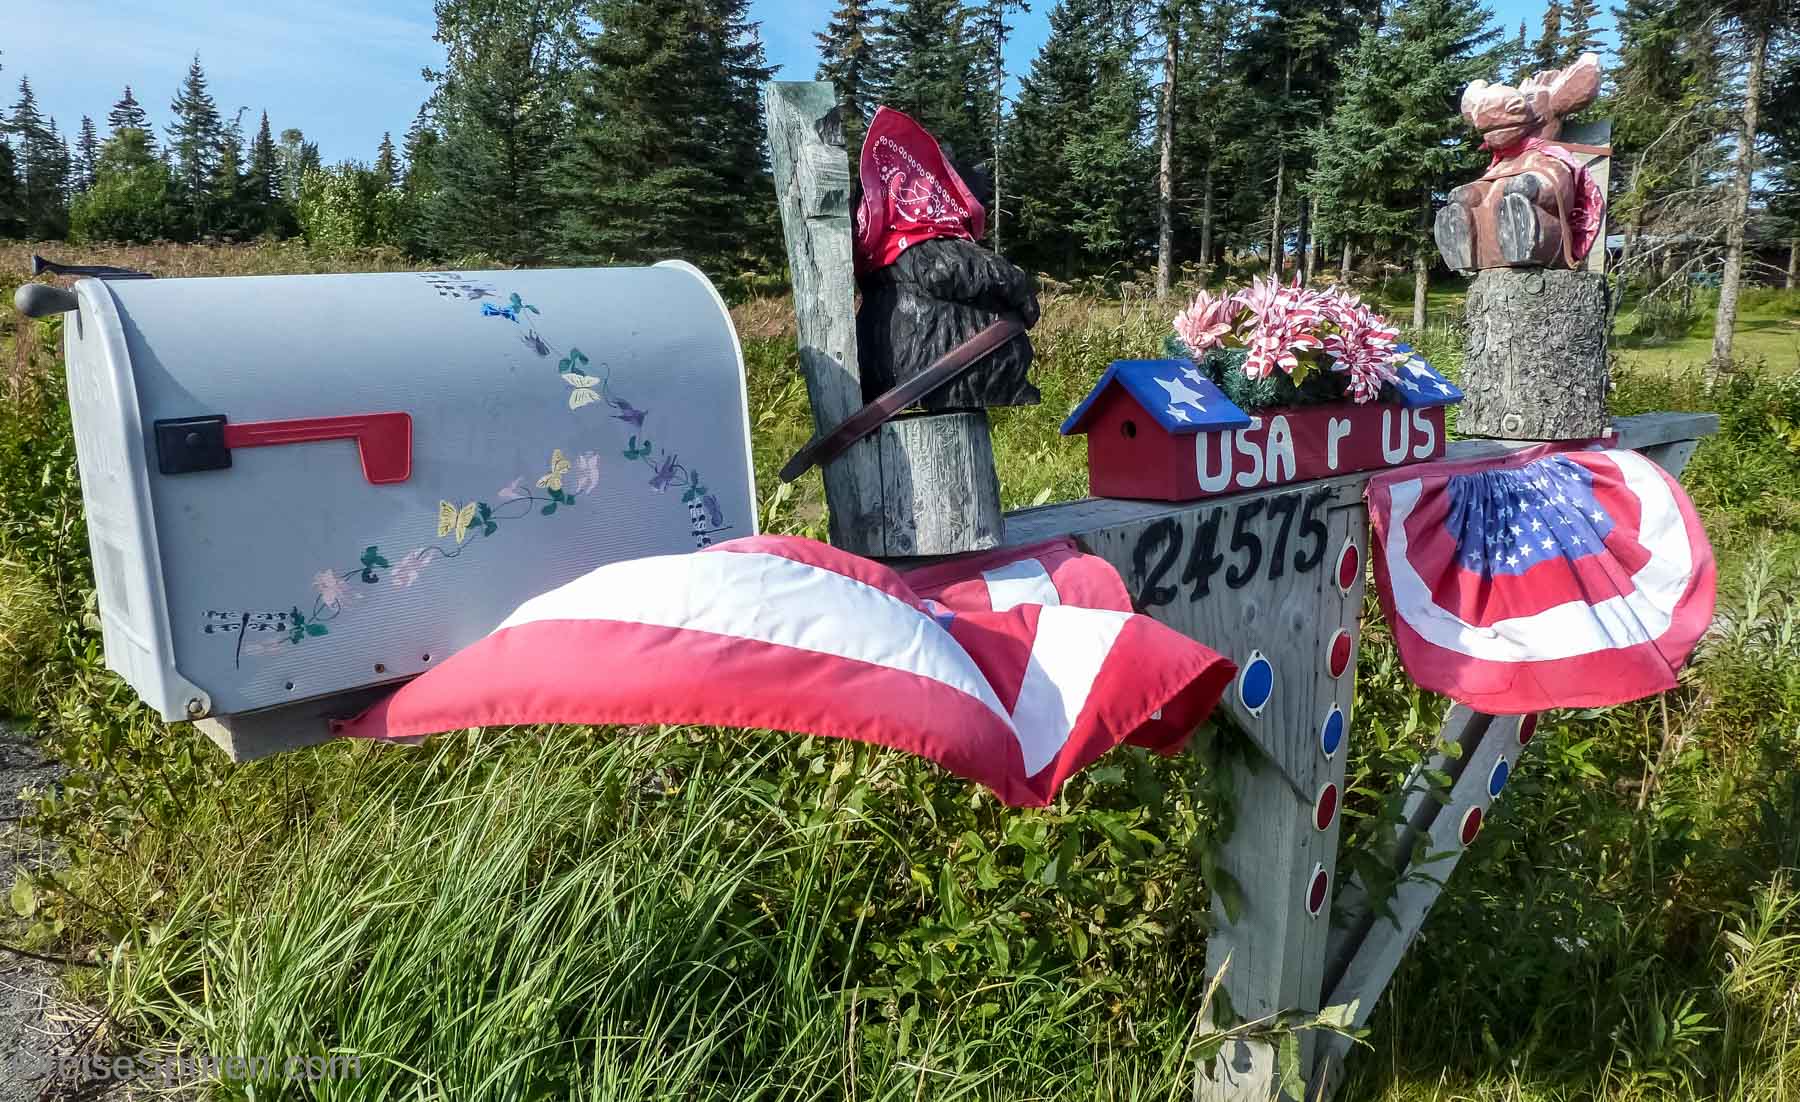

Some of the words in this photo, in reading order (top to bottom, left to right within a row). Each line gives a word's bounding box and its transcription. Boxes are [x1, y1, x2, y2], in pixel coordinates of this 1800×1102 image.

[1195, 415, 1297, 493] USA
[1327, 416, 1352, 470] r
[1381, 406, 1436, 465] US
[1131, 487, 1339, 610] 24575
